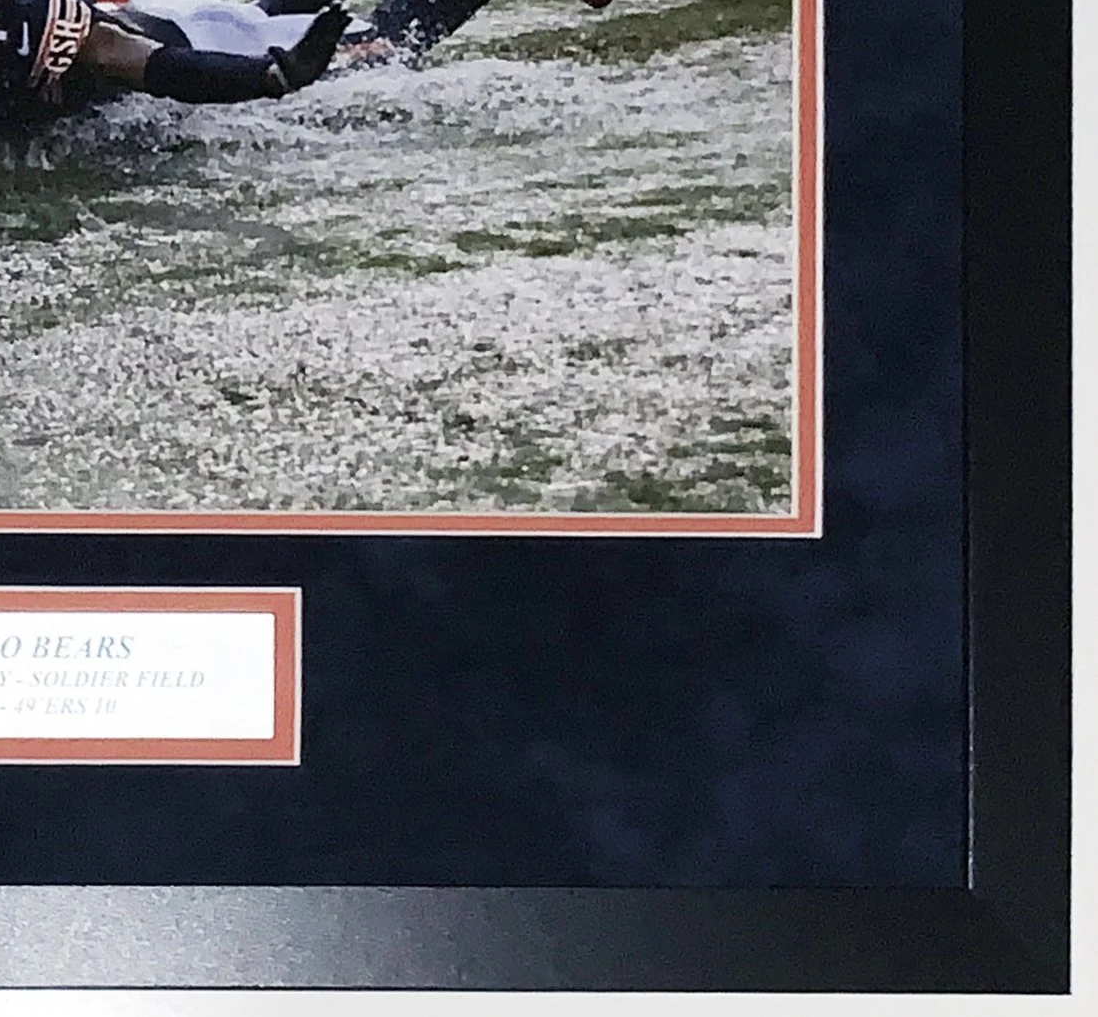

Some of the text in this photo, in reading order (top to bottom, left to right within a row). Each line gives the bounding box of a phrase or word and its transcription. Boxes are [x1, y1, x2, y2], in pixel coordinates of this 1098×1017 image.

[45, 18, 84, 73] GSH
[32, 634, 135, 660] BEARS
[29, 670, 129, 689] SOLDIER
[136, 670, 205, 689] FIELD
[95, 696, 118, 716] 10
